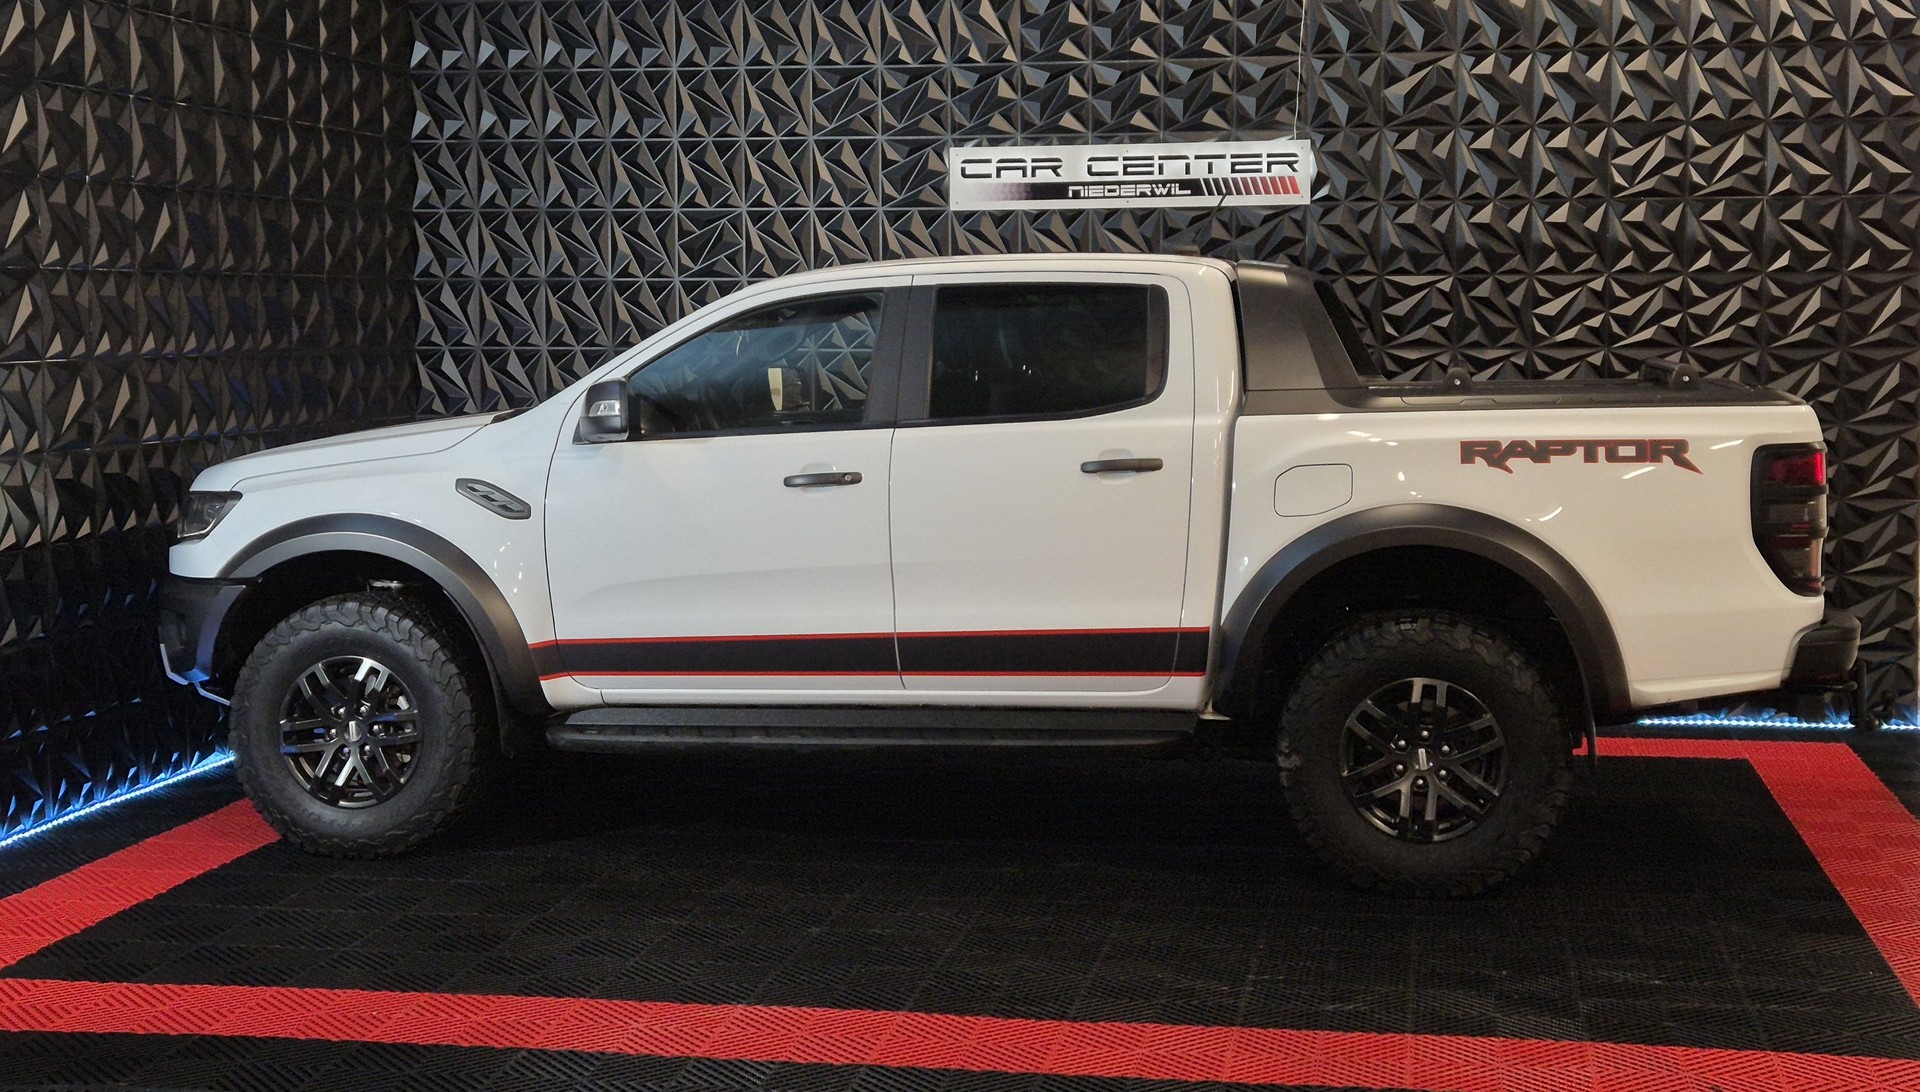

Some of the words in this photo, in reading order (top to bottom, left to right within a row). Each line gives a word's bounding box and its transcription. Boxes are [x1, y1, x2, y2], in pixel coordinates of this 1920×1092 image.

[960, 157, 1063, 179] CAR
[1087, 152, 1300, 177] CENTER
[1068, 183, 1192, 198] NIEDERWIL
[1460, 439, 1704, 476] RAPTOR
